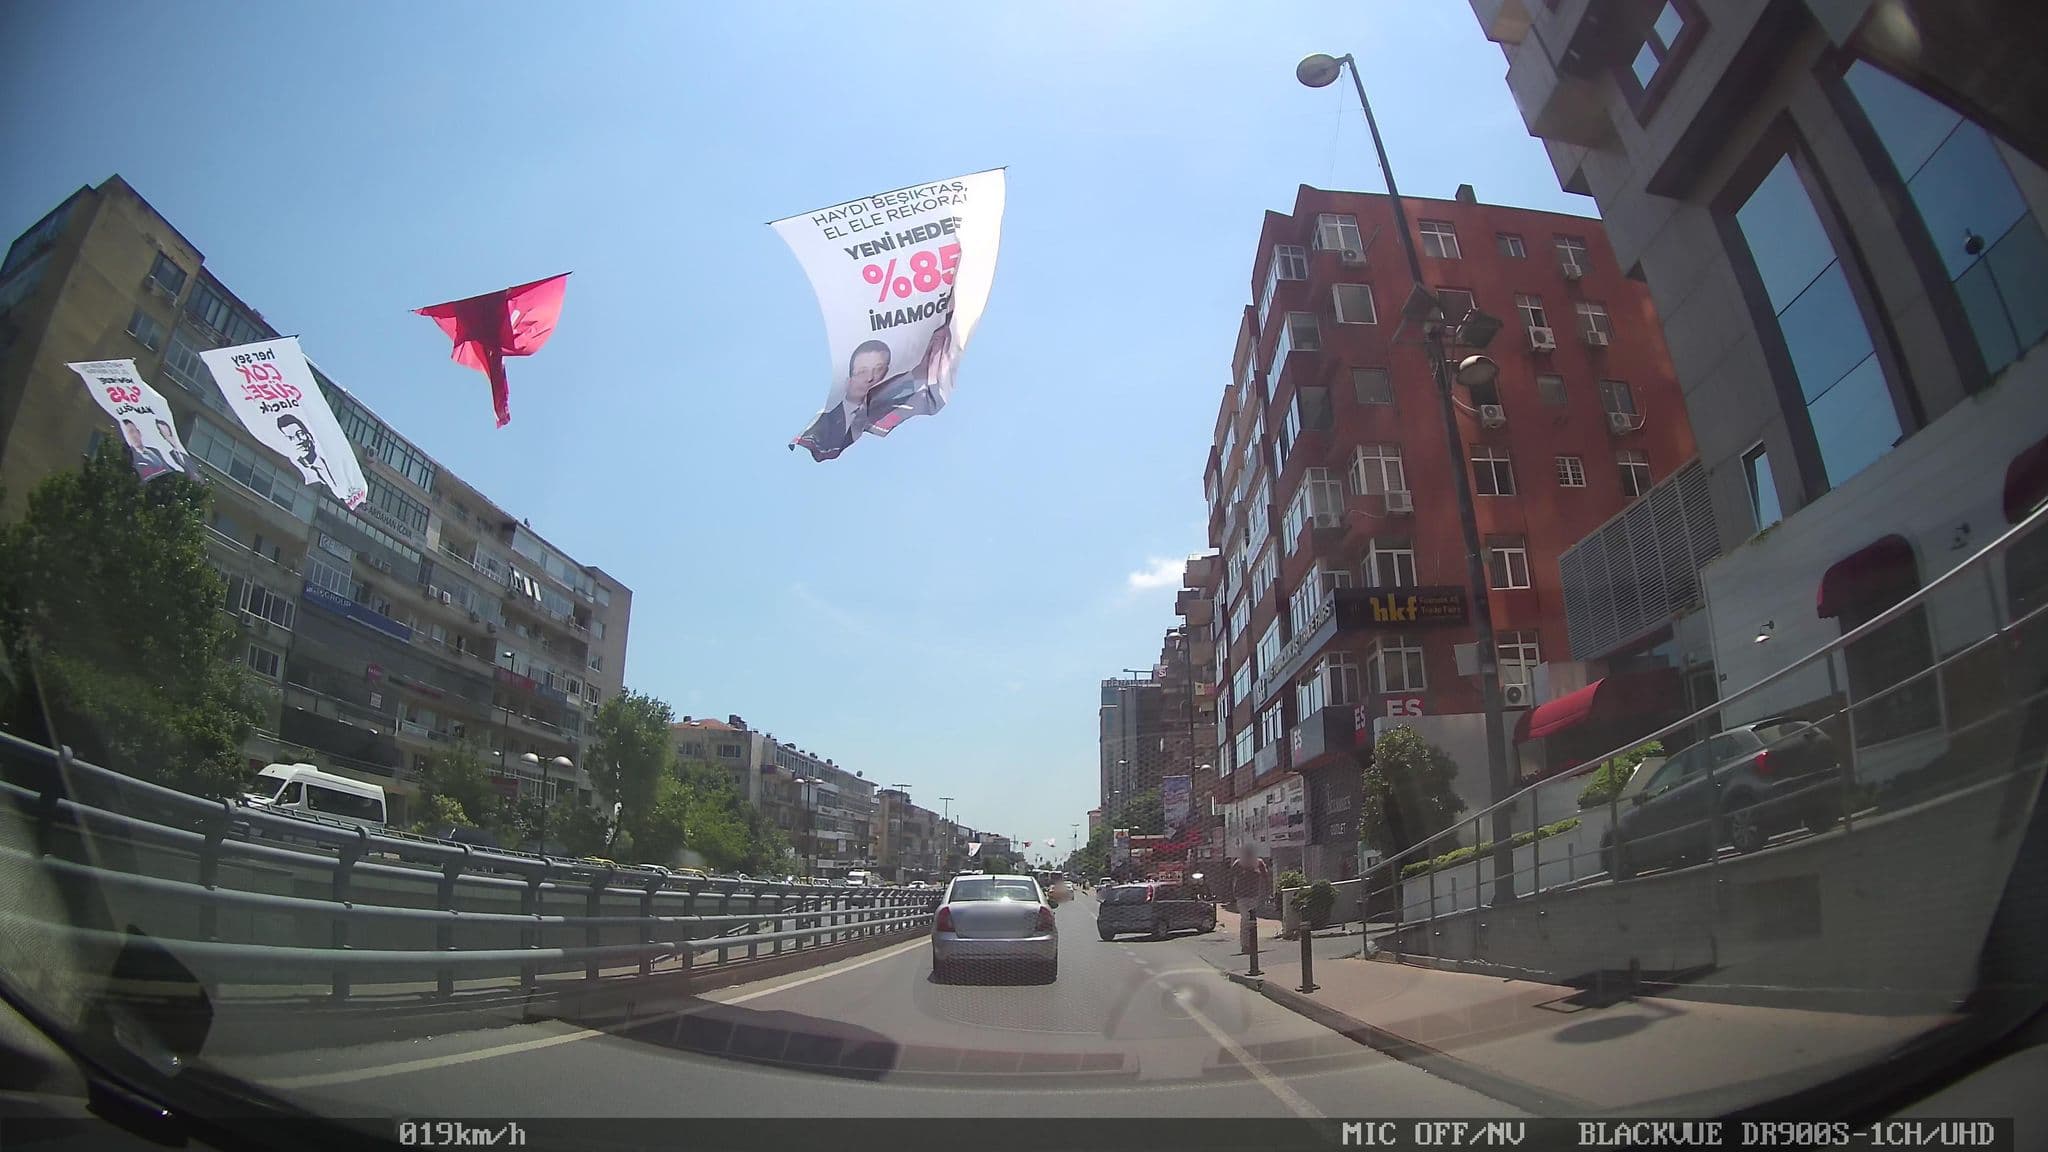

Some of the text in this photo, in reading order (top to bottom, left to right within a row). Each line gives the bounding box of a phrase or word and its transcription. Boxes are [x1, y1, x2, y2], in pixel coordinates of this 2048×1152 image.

[823, 220, 848, 241] EL
[850, 213, 884, 233] ELE
[844, 231, 897, 261] YENİ
[862, 242, 962, 303] %85
[1354, 705, 1366, 731] ES
[1387, 699, 1423, 718] ES
